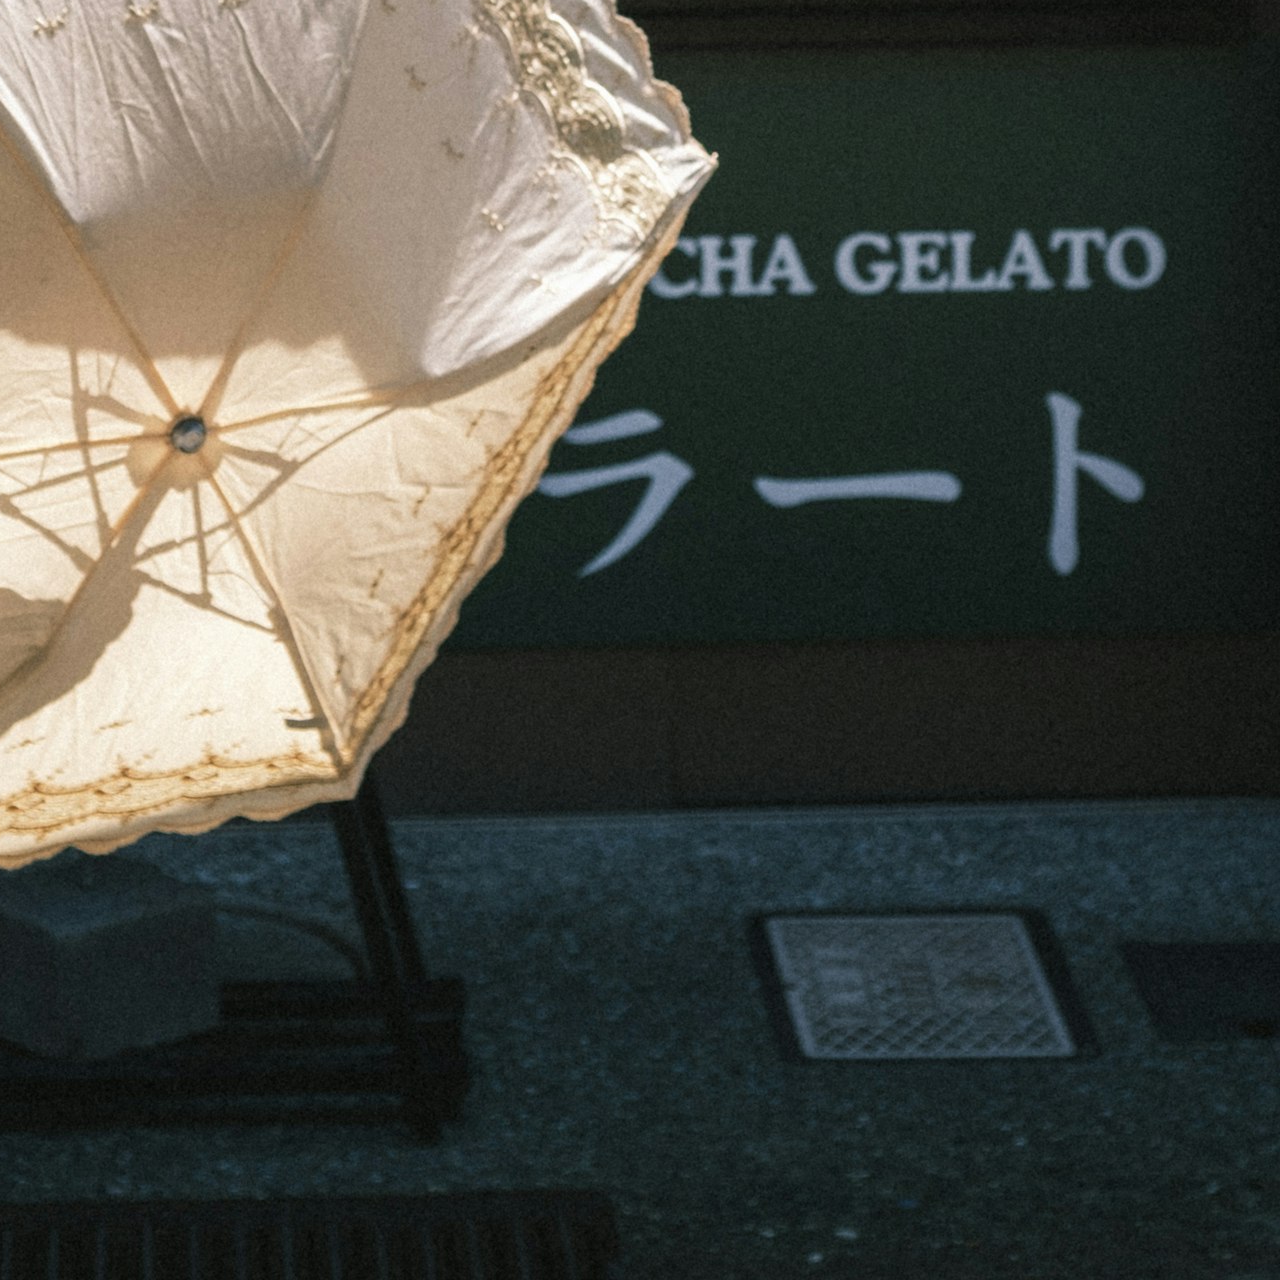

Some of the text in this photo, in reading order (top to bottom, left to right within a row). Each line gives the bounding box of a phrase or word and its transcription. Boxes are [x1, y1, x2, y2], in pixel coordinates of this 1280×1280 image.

[833, 226, 1168, 296] GELATO
[537, 390, 1146, 578] ラート
